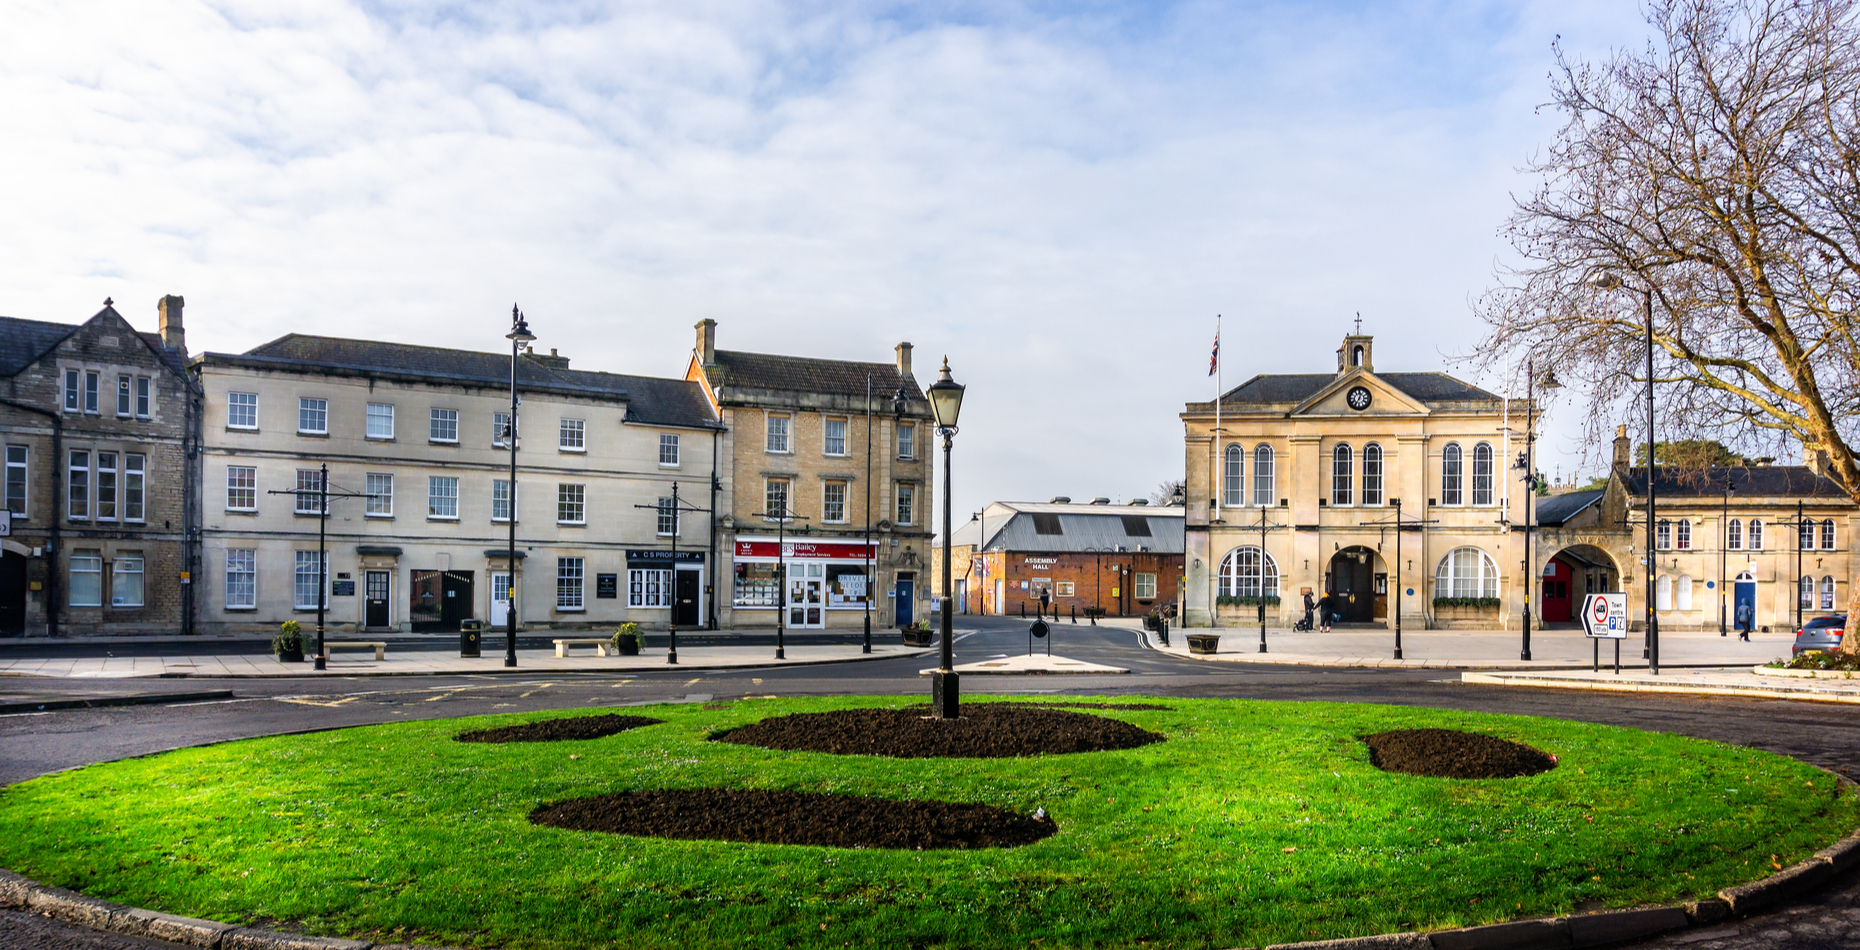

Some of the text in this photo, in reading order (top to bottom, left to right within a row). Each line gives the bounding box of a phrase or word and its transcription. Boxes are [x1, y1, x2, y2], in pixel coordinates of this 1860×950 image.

[795, 543, 818, 553] Bailey
[838, 574, 870, 582] DRIVER
[1611, 618, 1616, 629] P
